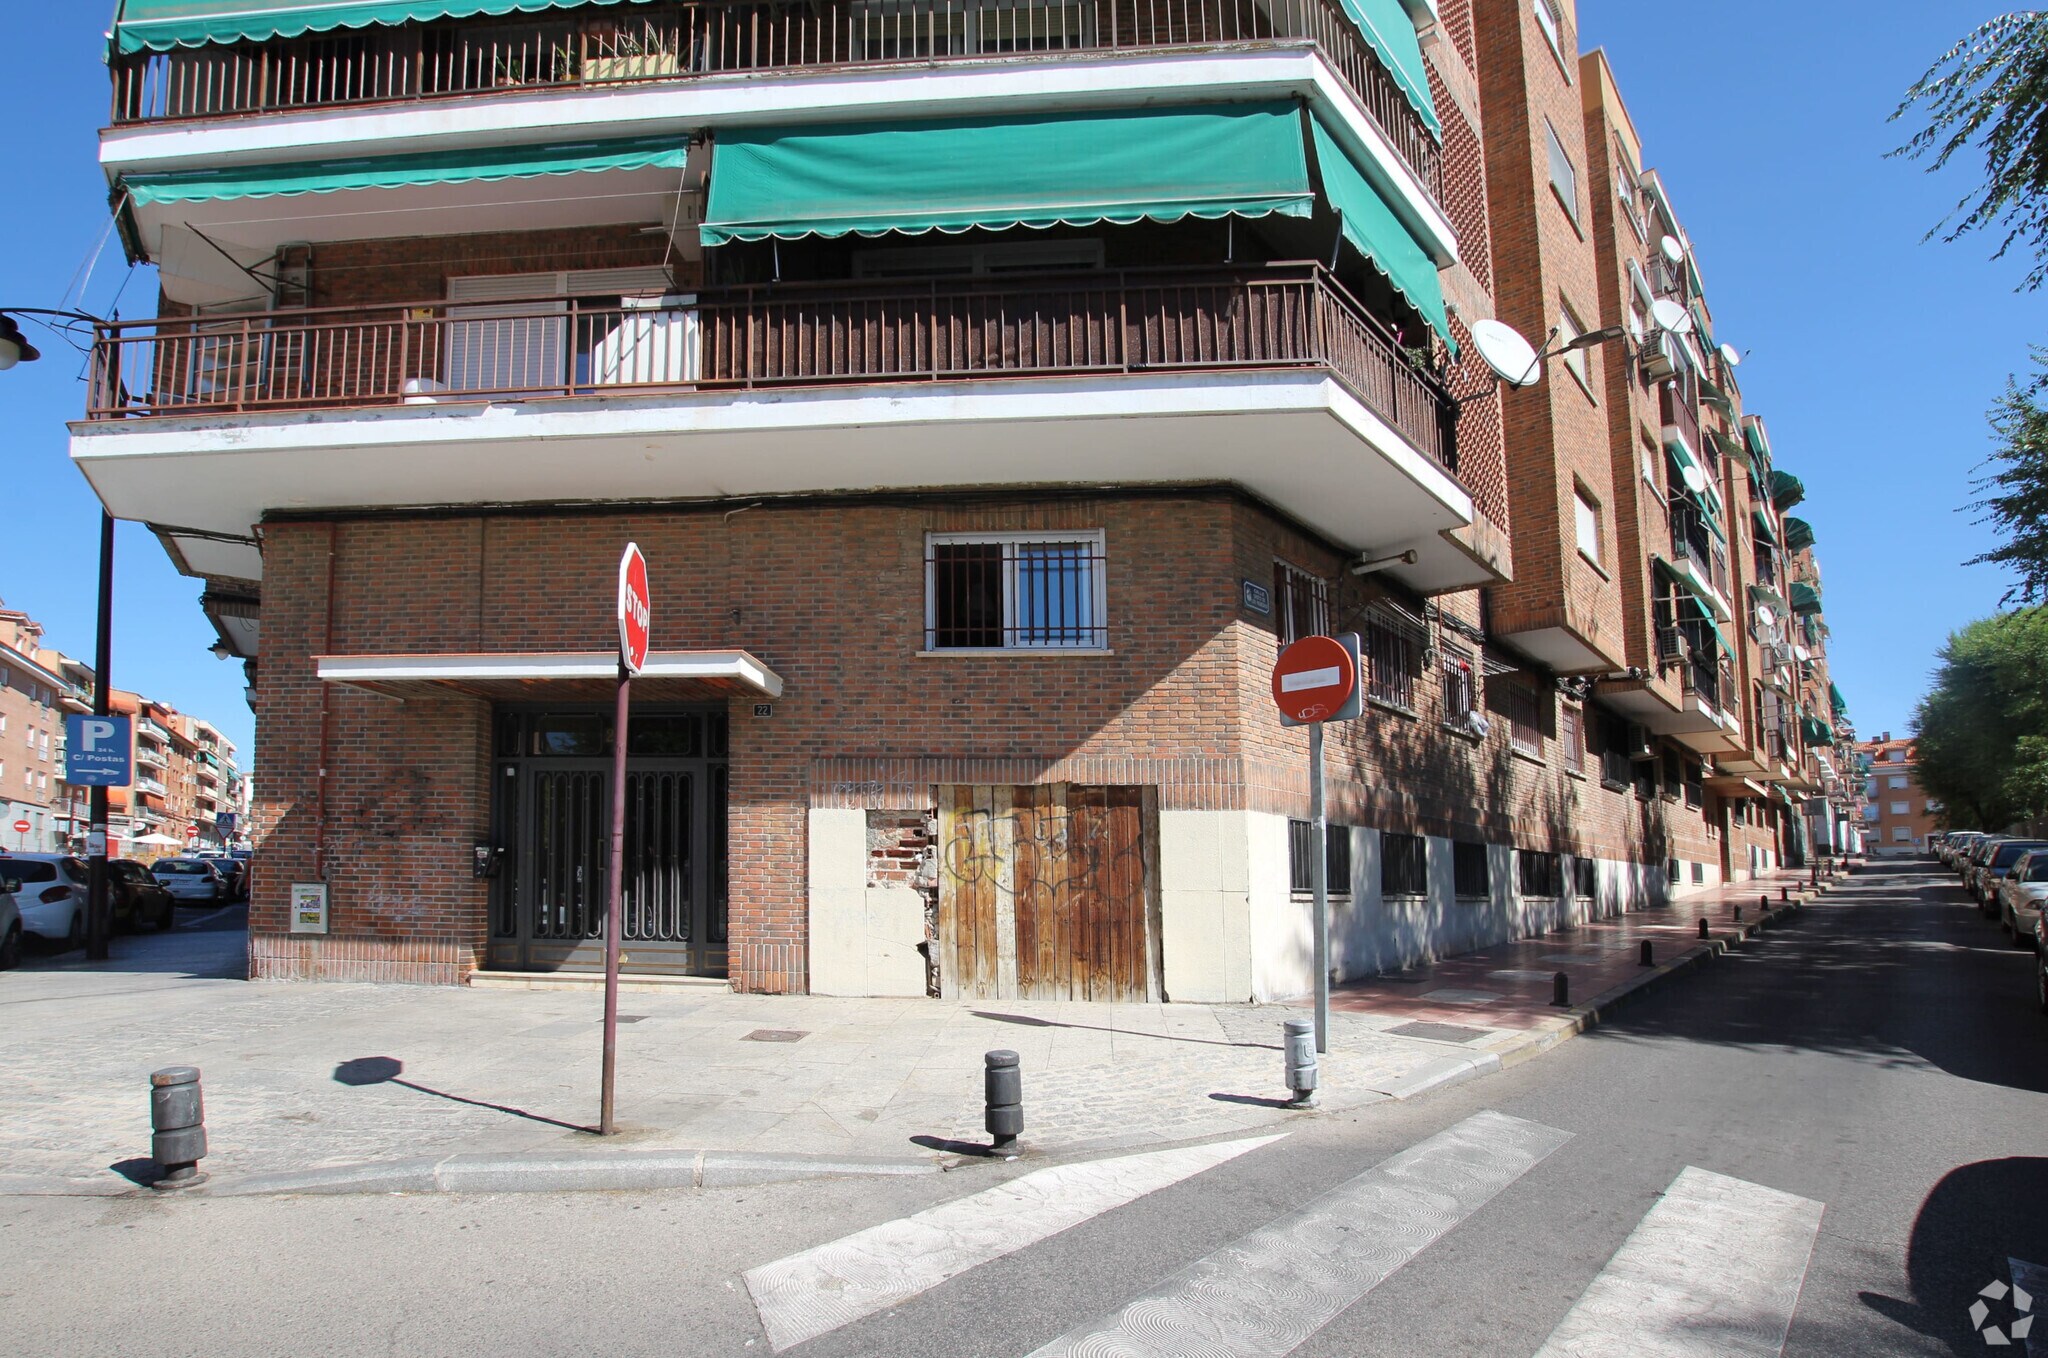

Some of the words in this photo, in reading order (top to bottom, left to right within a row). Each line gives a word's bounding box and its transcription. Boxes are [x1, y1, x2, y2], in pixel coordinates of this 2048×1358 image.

[626, 583, 648, 632] STOP
[757, 705, 768, 715] 22
[82, 720, 115, 751] P
